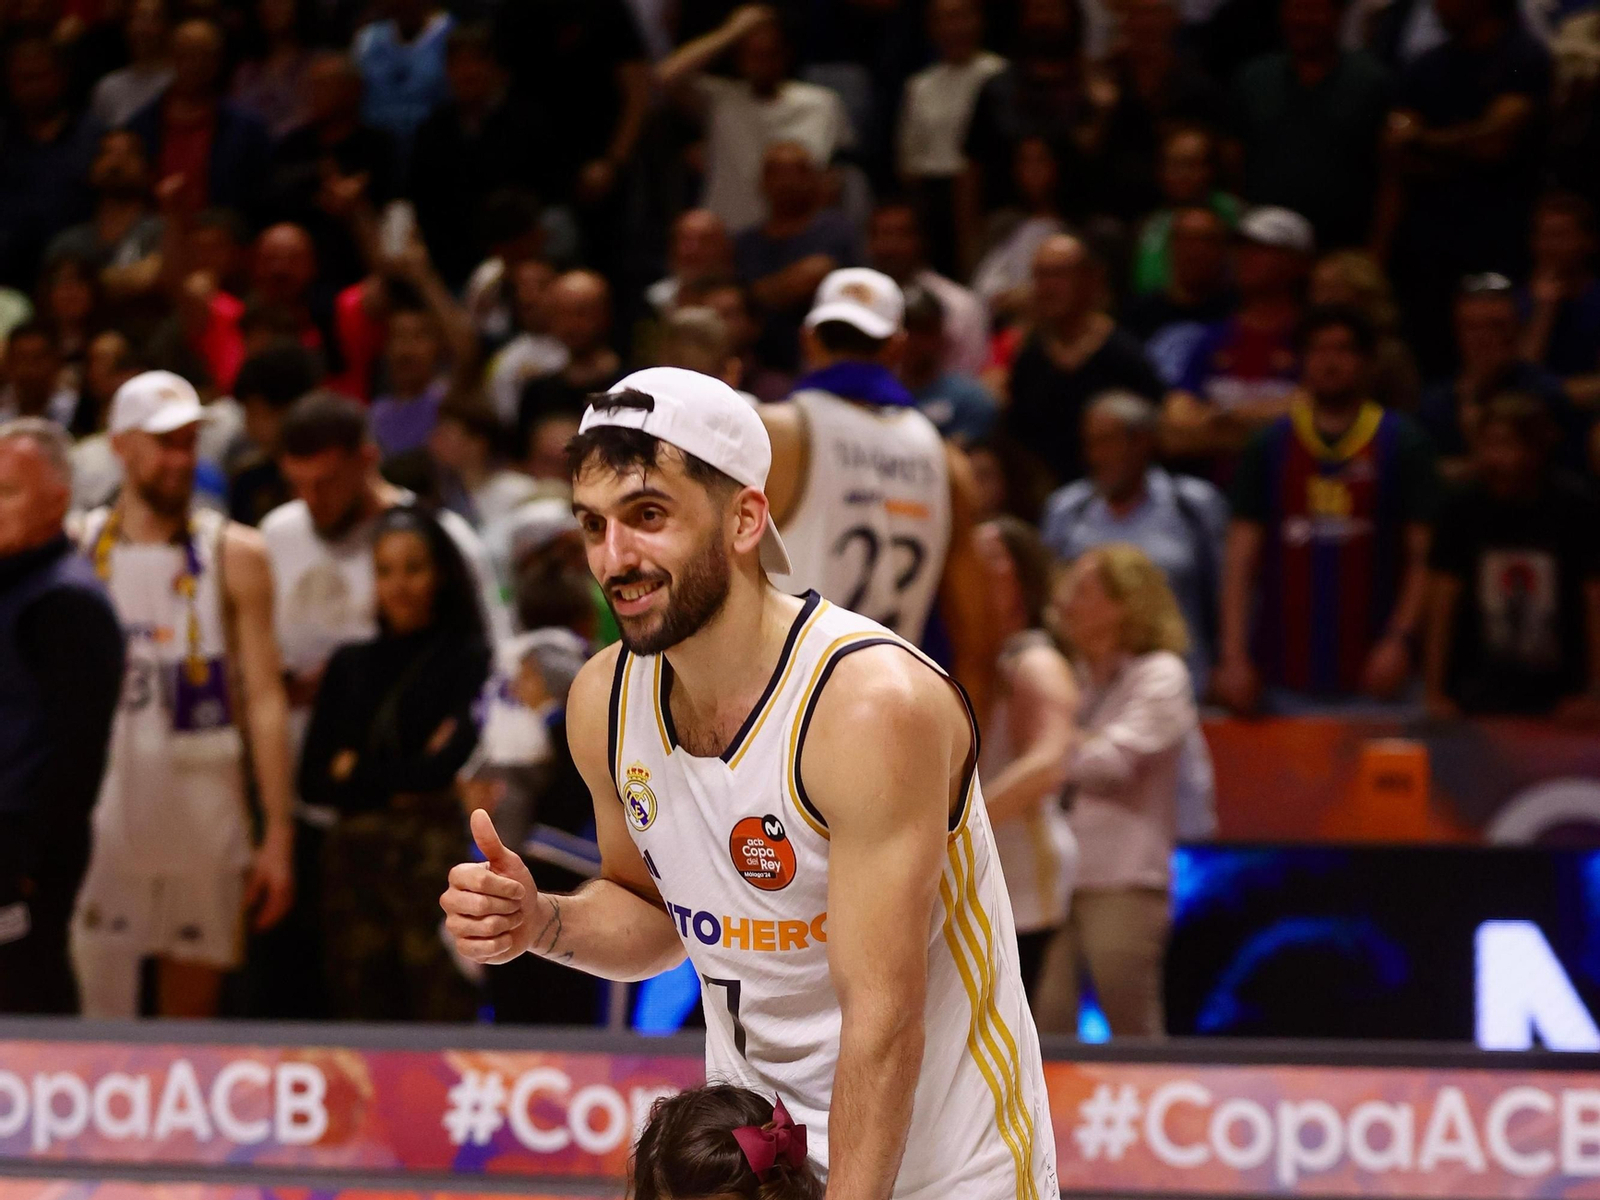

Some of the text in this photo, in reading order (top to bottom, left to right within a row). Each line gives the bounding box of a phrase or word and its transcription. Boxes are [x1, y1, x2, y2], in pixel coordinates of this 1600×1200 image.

[747, 838, 764, 846] acb
[742, 846, 775, 858] Copa
[760, 859, 781, 873] Rey
[667, 900, 827, 951] TOHERO
[1074, 1081, 1600, 1187] #CopaACB
